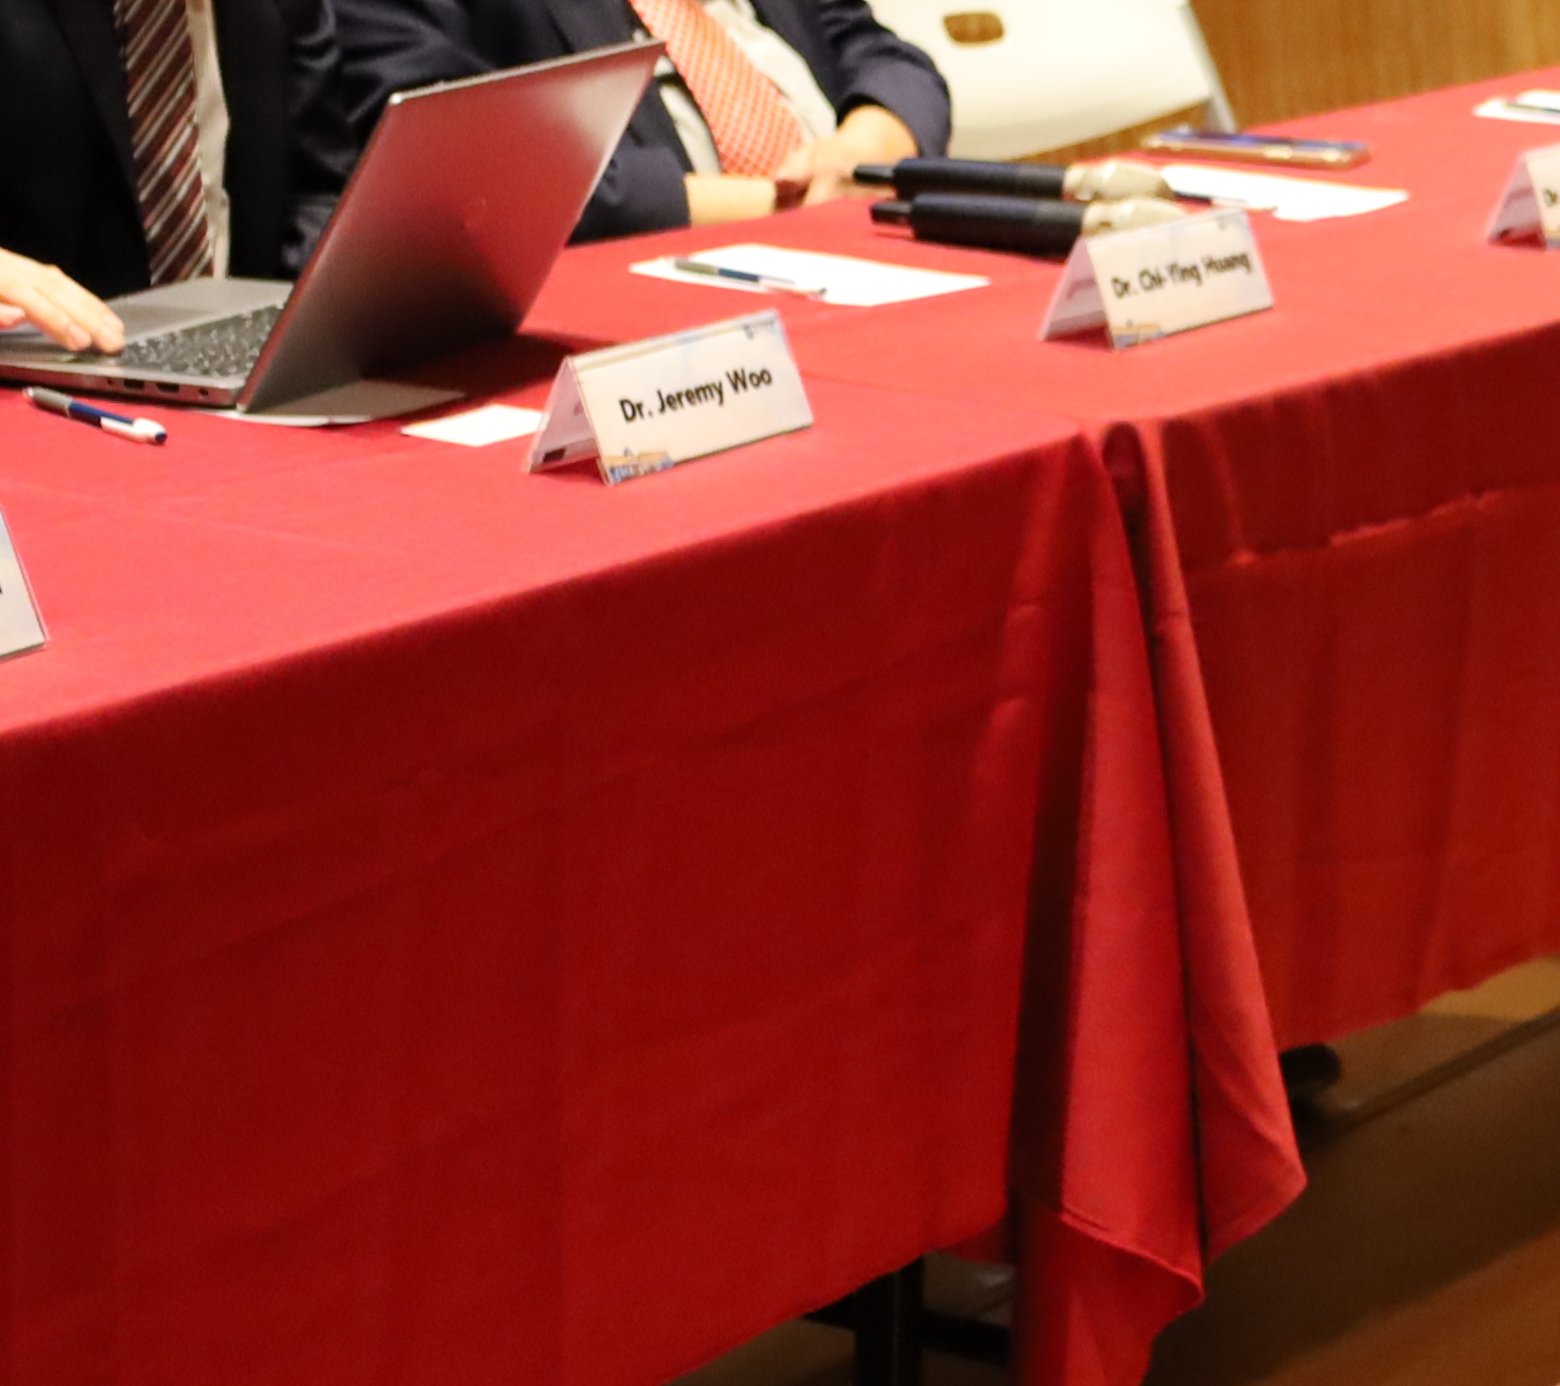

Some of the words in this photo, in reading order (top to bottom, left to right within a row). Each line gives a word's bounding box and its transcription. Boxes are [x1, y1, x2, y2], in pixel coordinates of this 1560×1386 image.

[1111, 276, 1138, 298] Dr.
[1202, 252, 1252, 276] Huang
[618, 398, 653, 424] Dr.
[656, 381, 724, 415] Jeremy
[725, 366, 774, 394] Woo
